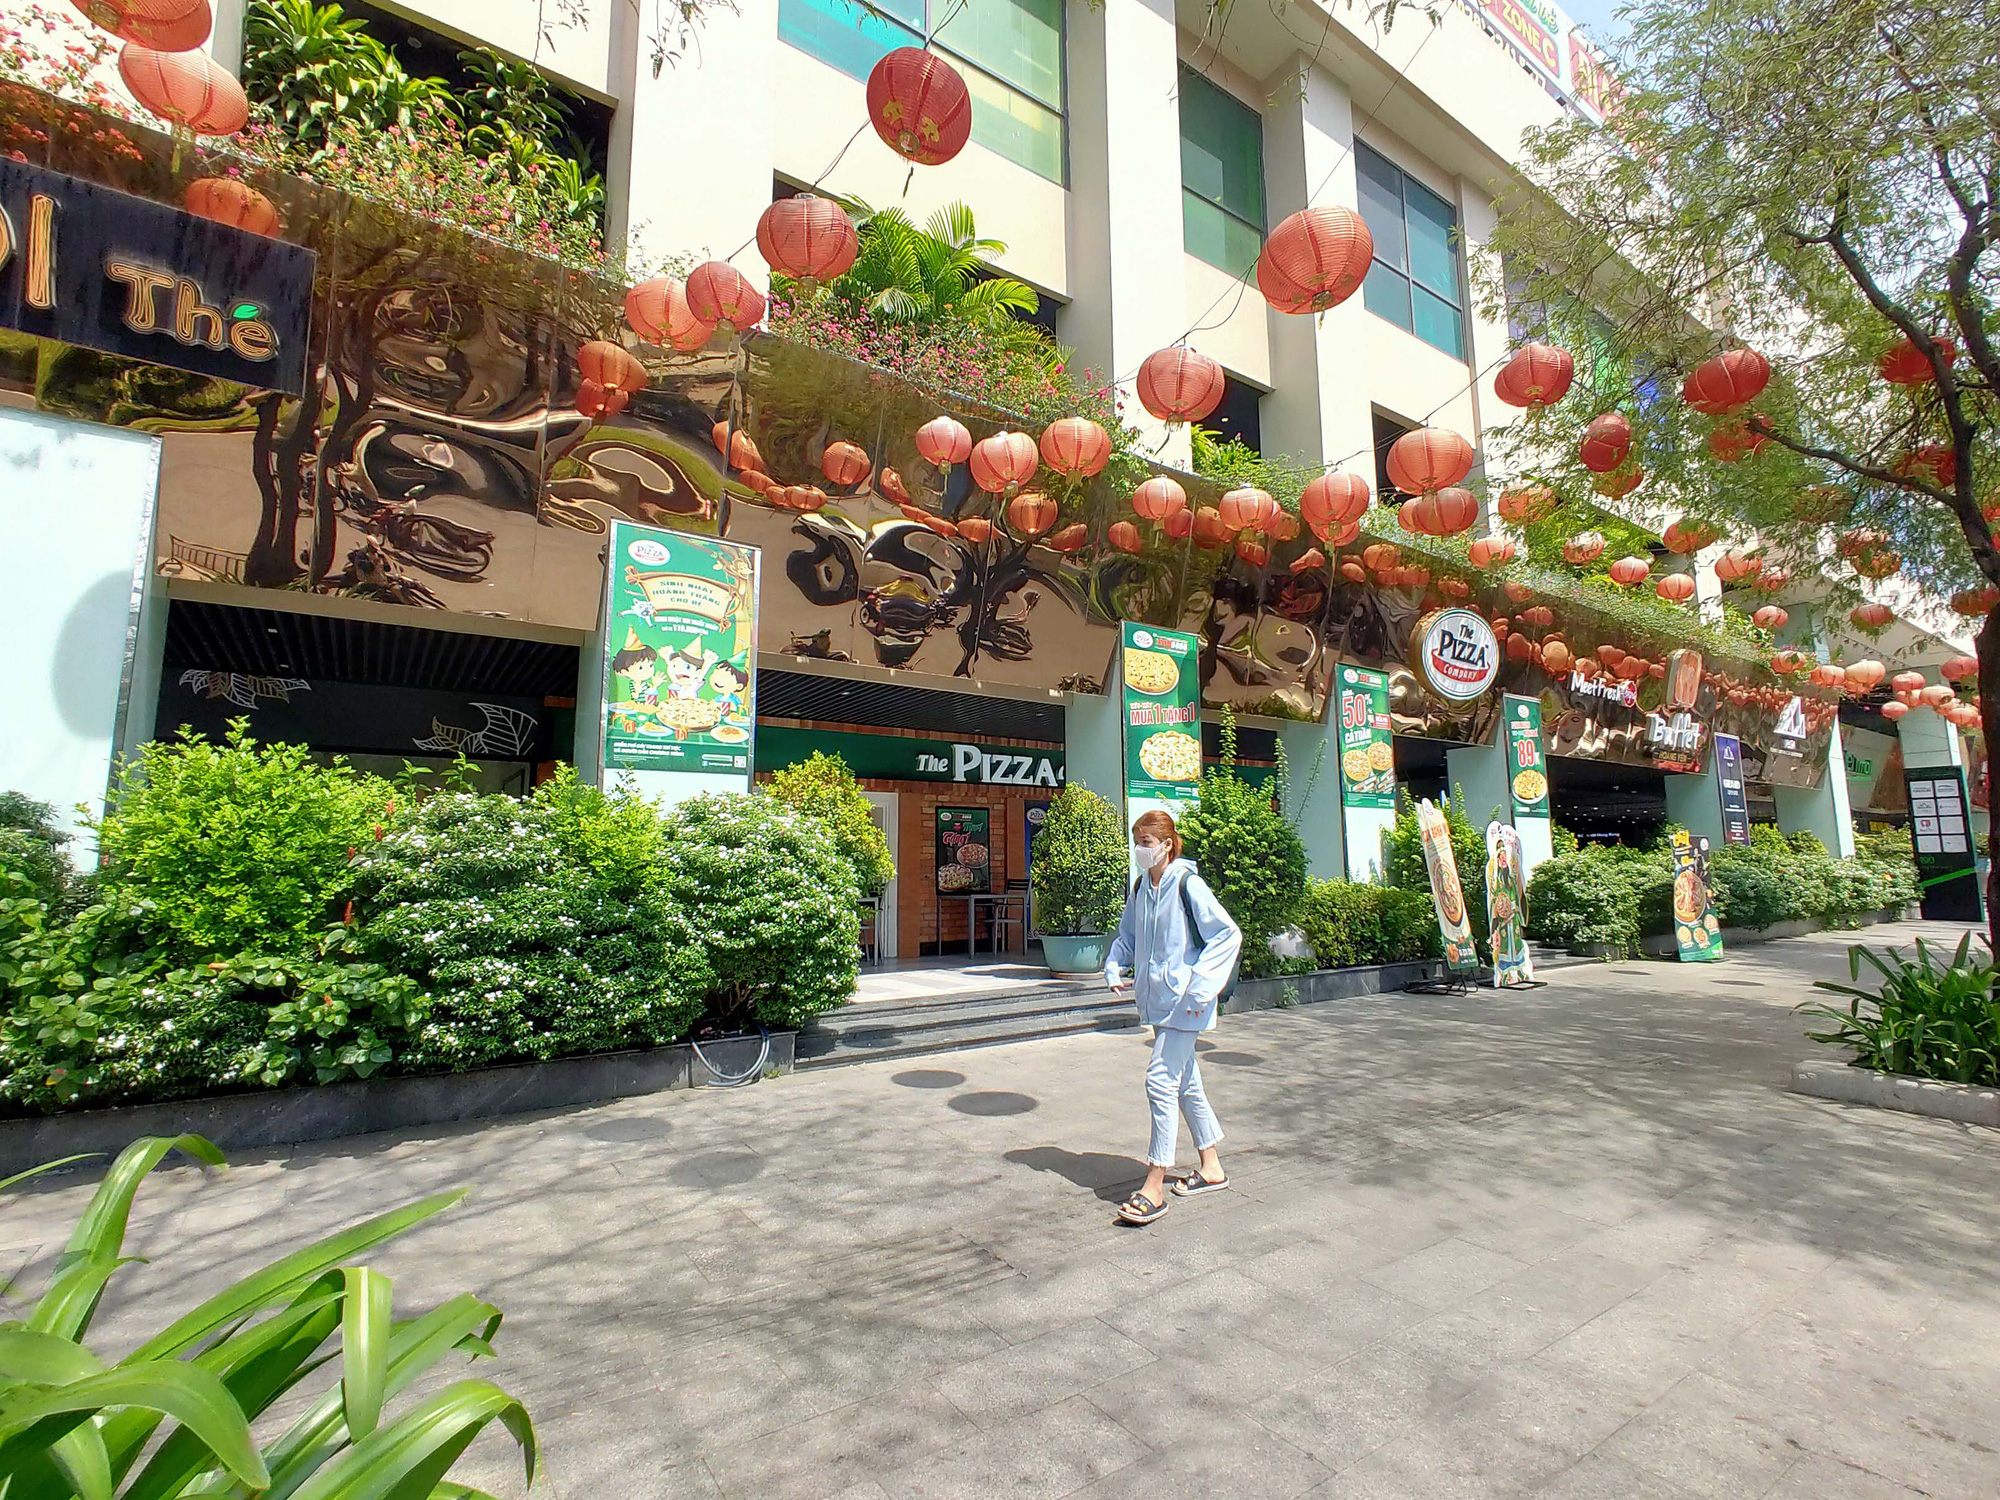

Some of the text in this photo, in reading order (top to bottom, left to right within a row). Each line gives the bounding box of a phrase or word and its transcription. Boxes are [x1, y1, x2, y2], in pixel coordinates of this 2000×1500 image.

[1502, 1, 1542, 54] ZONE
[1541, 37, 1557, 69] C
[1437, 628, 1486, 668] PIZZA
[1460, 624, 1474, 640] The
[1443, 663, 1478, 681] Company
[1130, 709, 1154, 726] MUA
[1154, 703, 1162, 725] 1
[1187, 701, 1196, 722] 1
[1651, 713, 1701, 750] Buffet
[916, 754, 949, 772] The
[951, 743, 1059, 787] PIZZA
